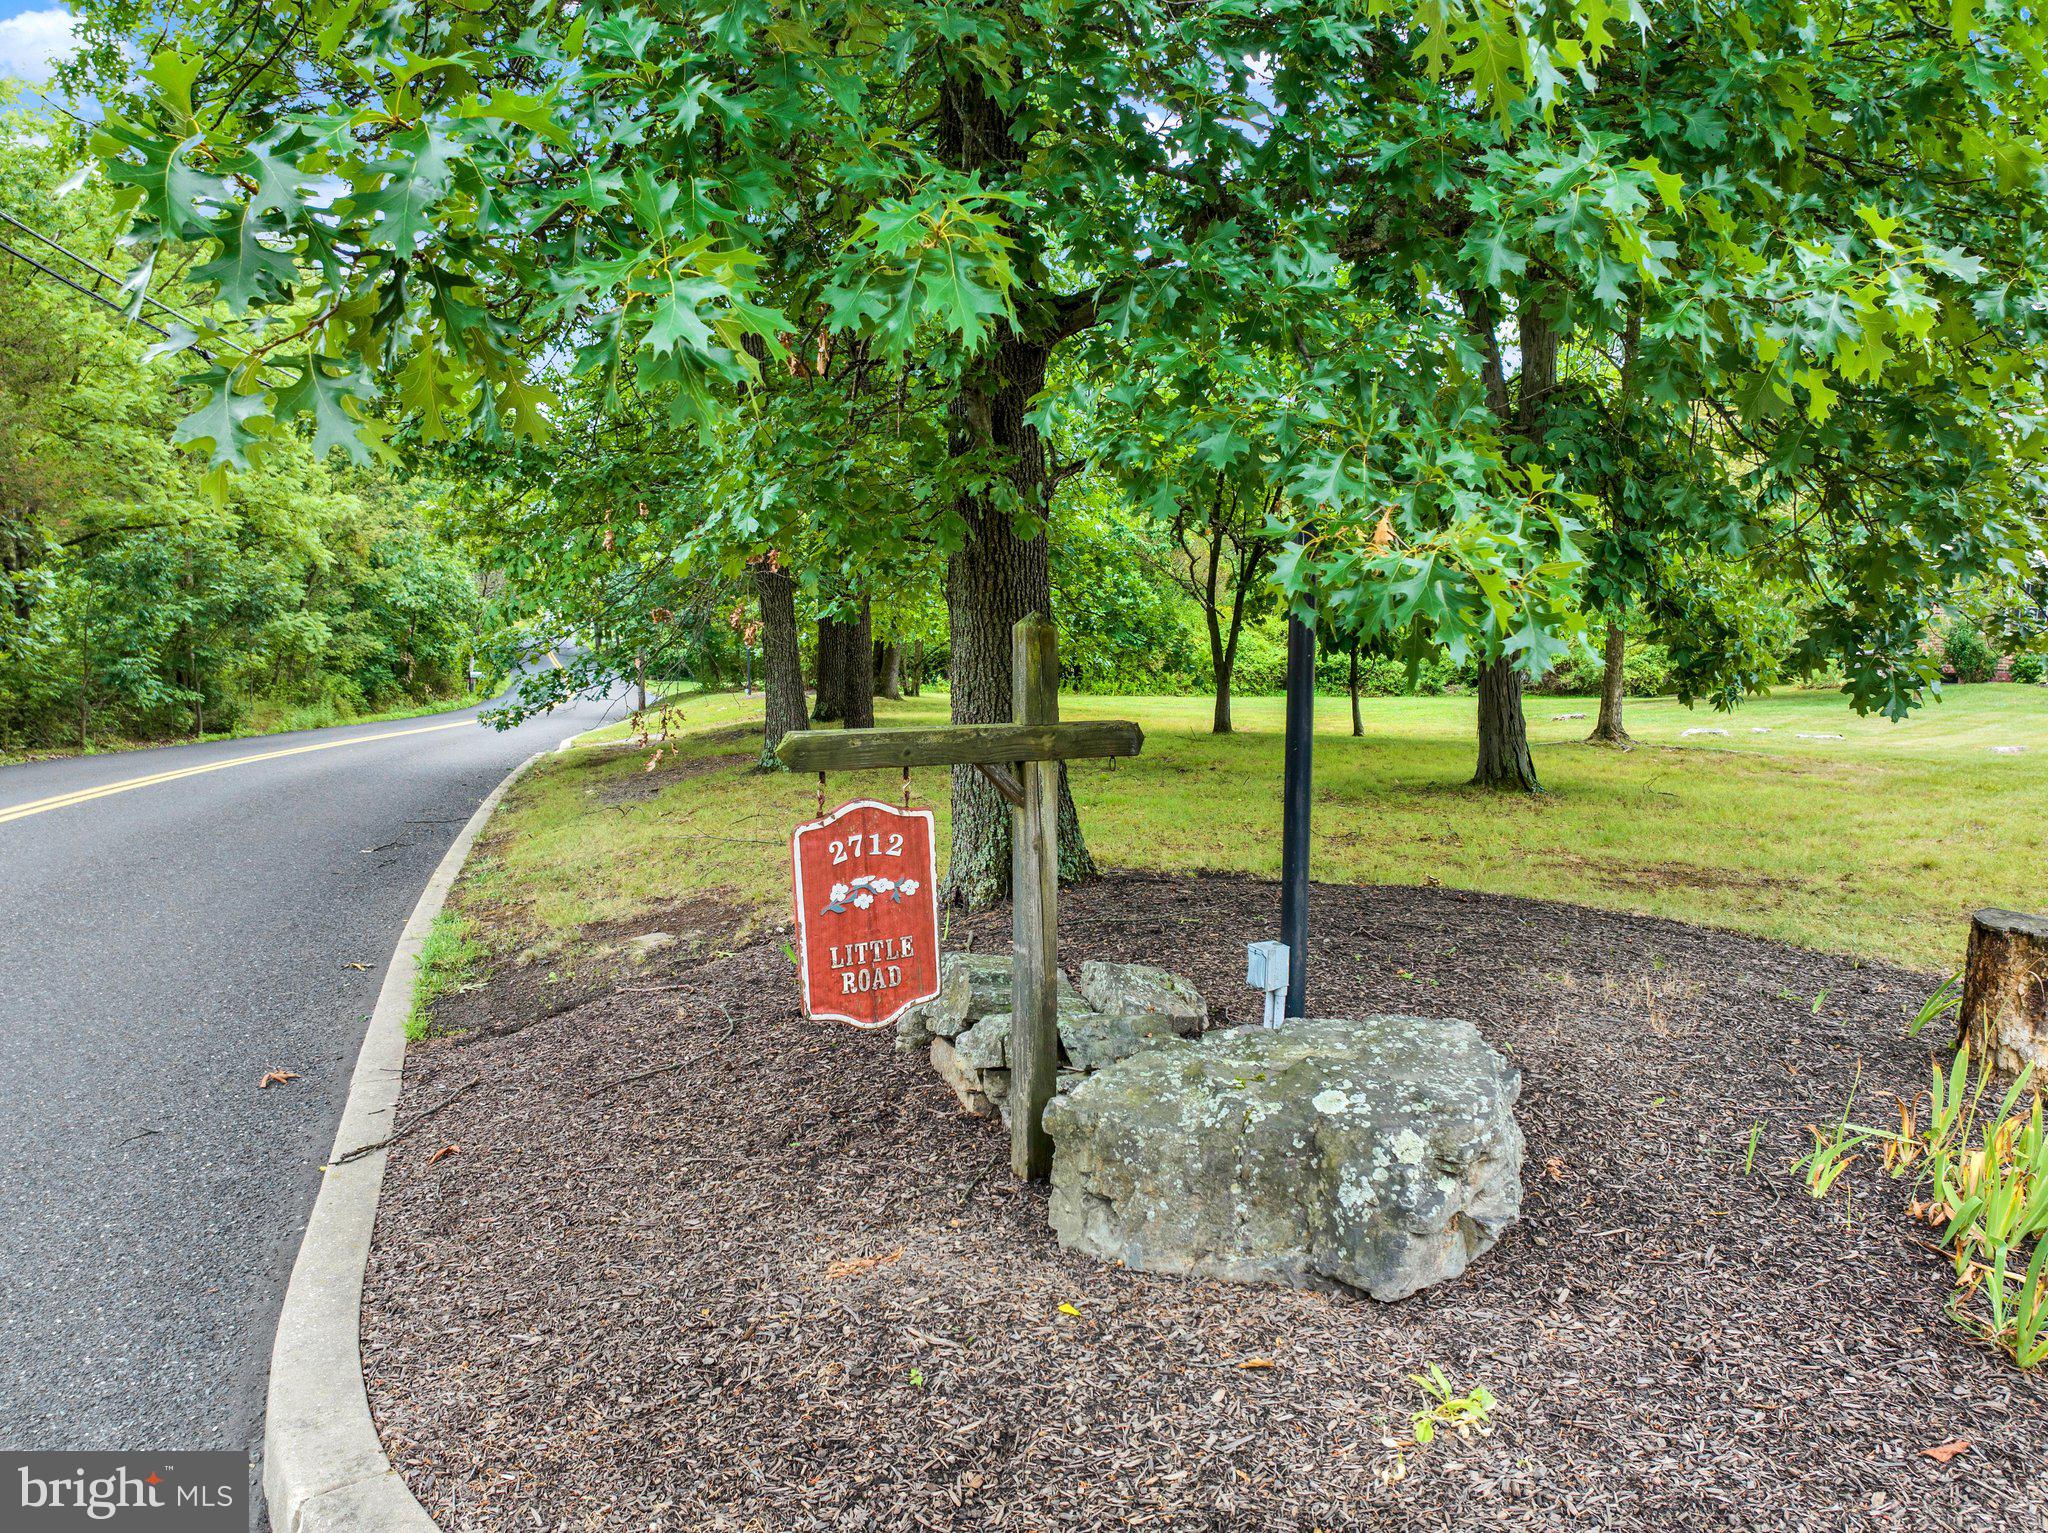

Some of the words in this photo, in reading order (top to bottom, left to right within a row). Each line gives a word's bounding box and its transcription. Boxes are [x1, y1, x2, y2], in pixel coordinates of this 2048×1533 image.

[828, 833, 904, 866] 2712
[829, 935, 915, 969] LITTLE
[841, 965, 902, 995] ROAD
